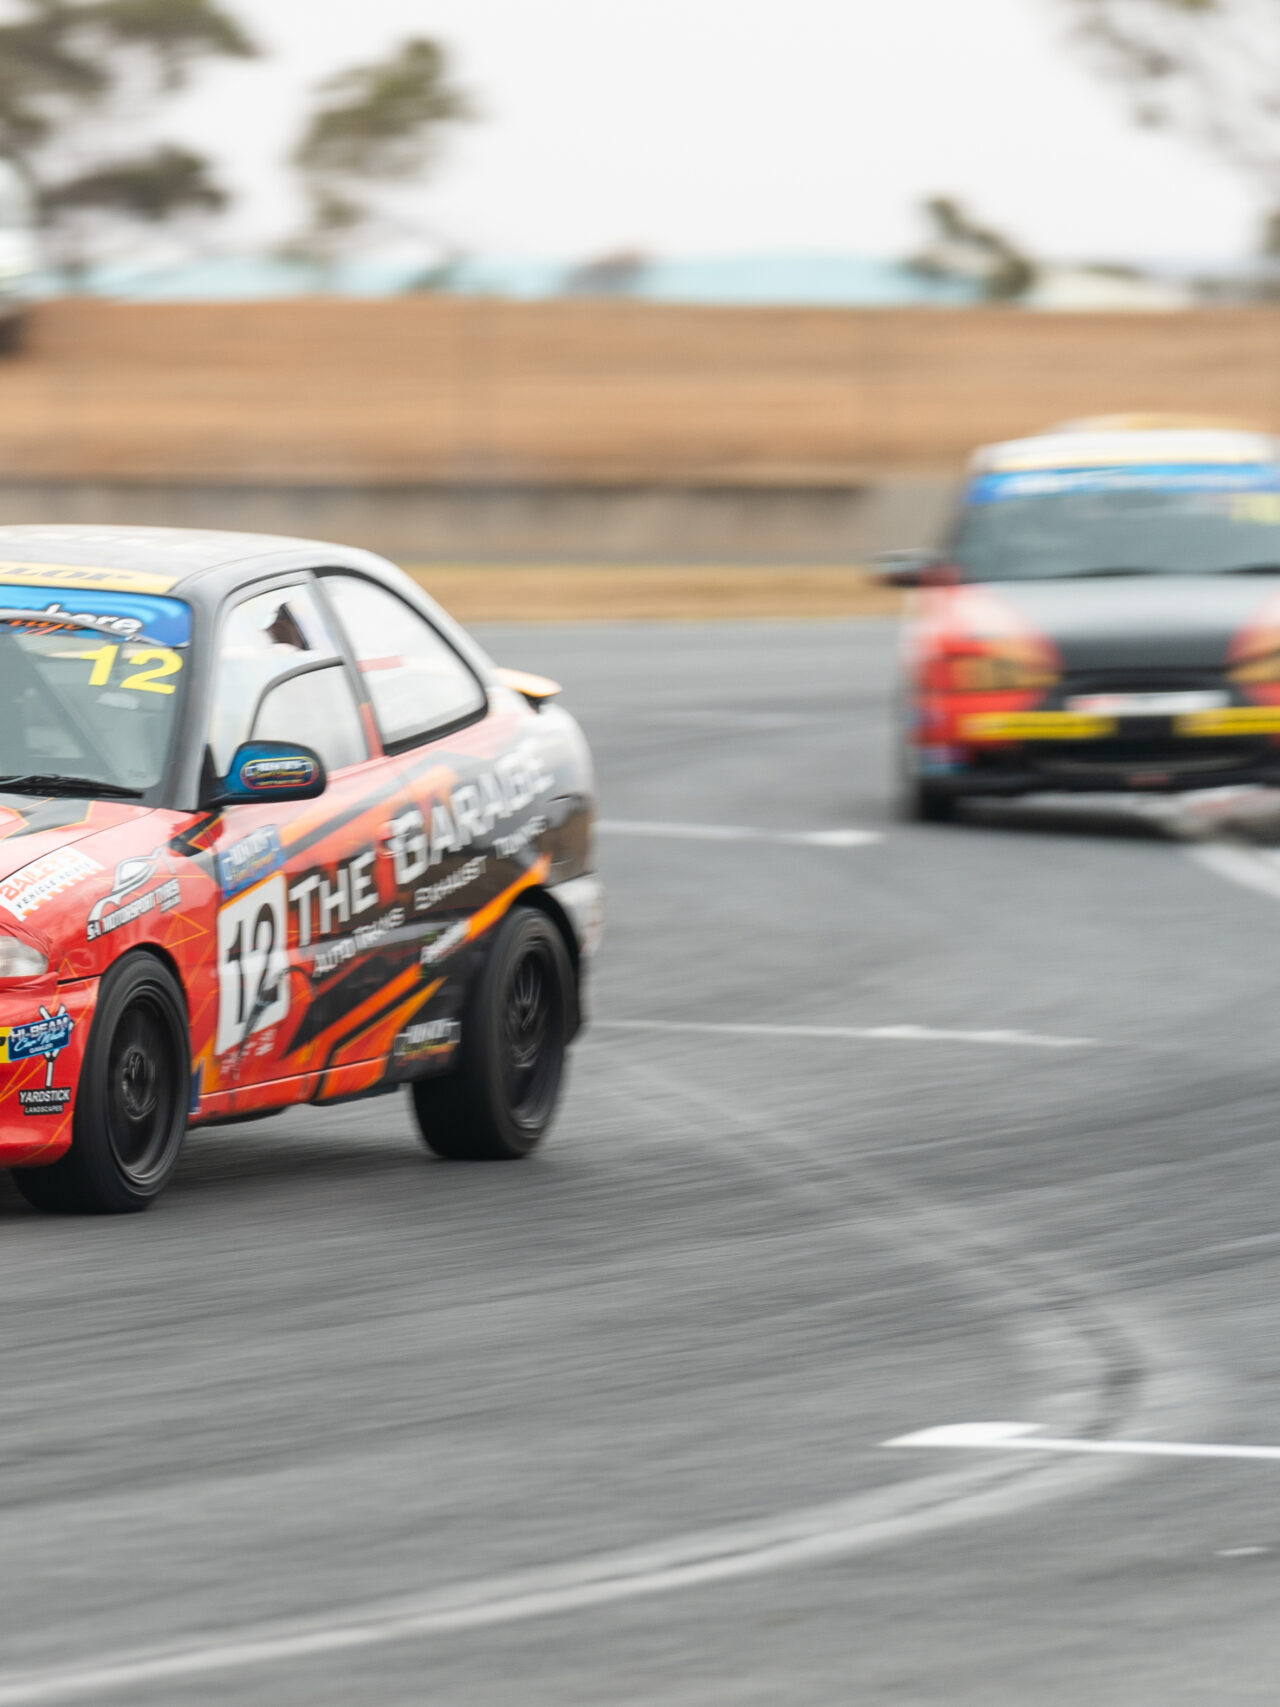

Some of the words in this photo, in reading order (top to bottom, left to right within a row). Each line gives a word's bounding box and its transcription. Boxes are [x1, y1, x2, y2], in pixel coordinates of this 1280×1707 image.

[80, 645, 183, 695] 12
[288, 850, 379, 947] THE
[226, 902, 279, 1026] 12
[9, 1016, 69, 1042] HI-BEAM
[19, 1088, 71, 1104] YARDSTICK
[24, 1104, 64, 1114] LANDSCAPES
